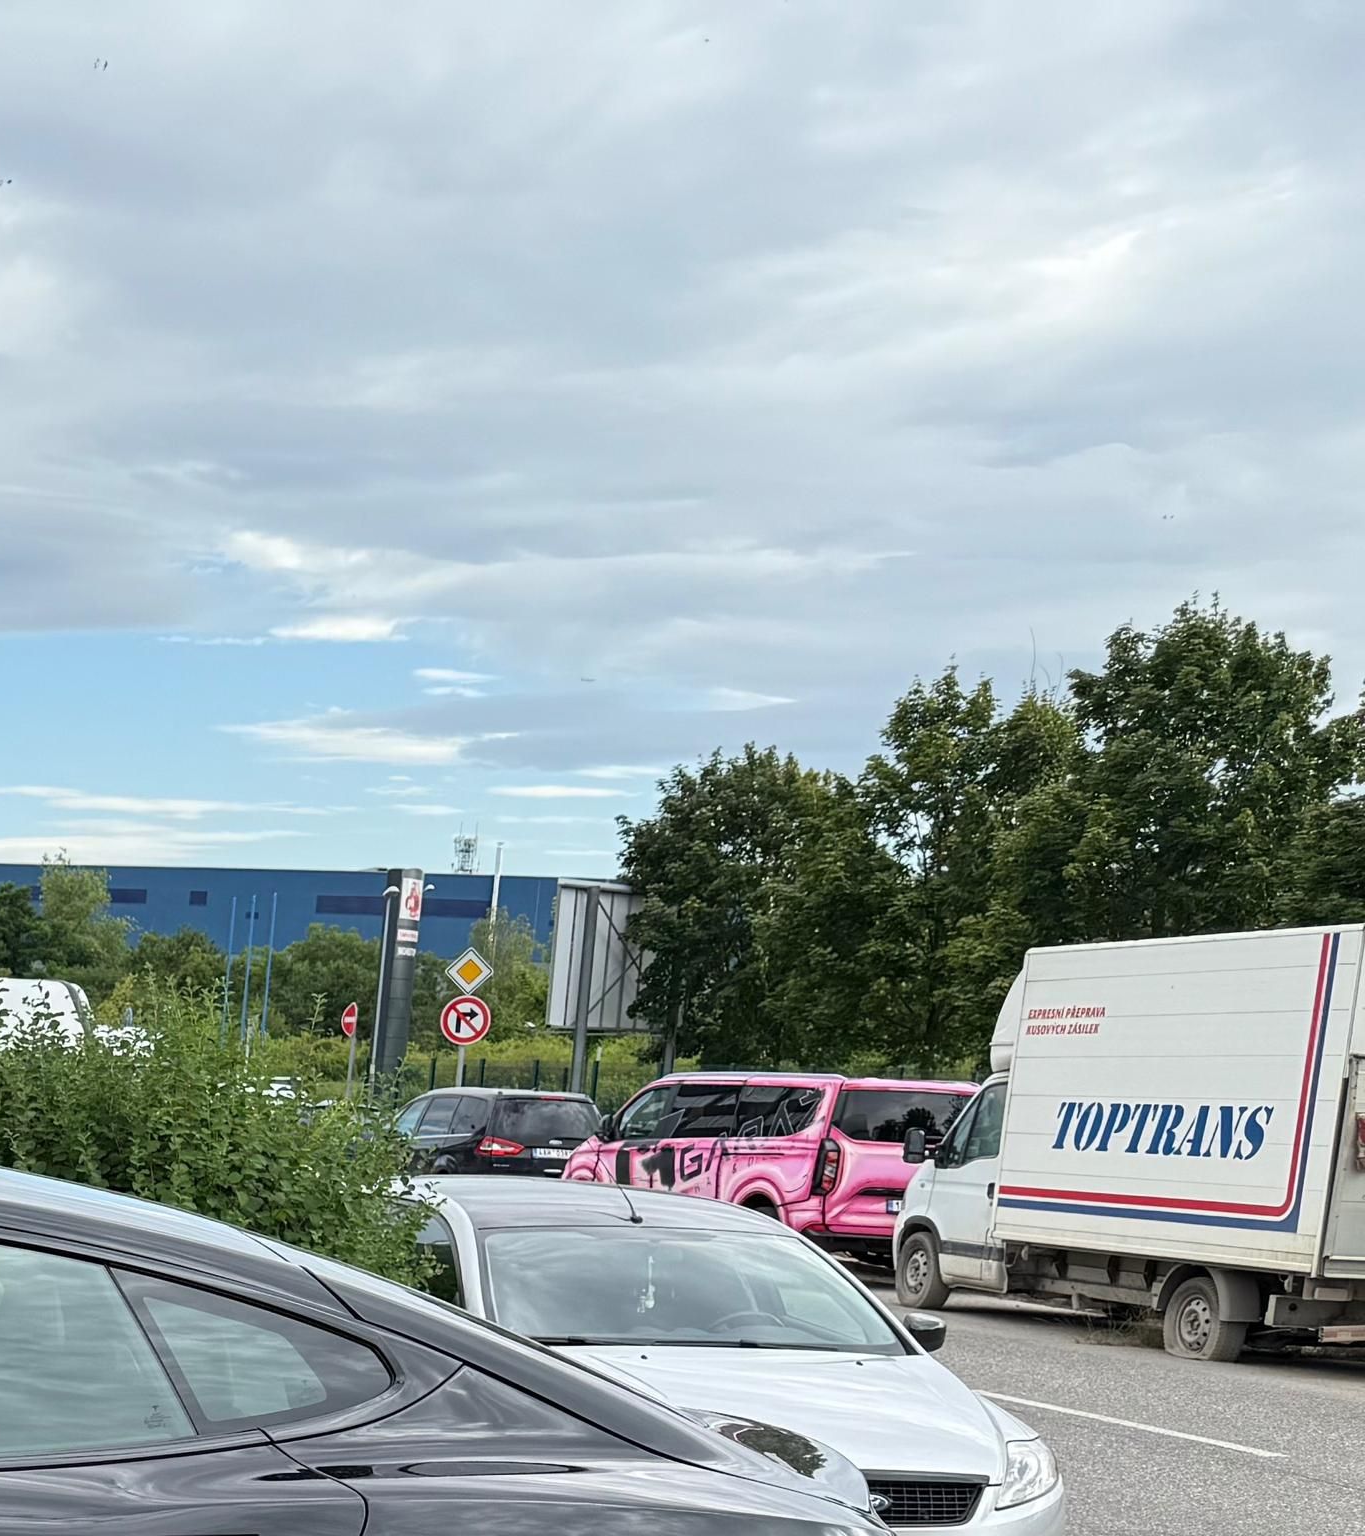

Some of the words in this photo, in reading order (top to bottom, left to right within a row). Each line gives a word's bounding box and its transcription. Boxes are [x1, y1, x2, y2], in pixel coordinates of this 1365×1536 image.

[1028, 1006, 1066, 1019] EXPRESNÍ
[1066, 1005, 1106, 1018] PŘEPRAVA
[1026, 1022, 1066, 1035] KUSOVÝCH
[1067, 1022, 1100, 1035] ZÁSILEK
[1052, 1101, 1274, 1161] TOPTRANS
